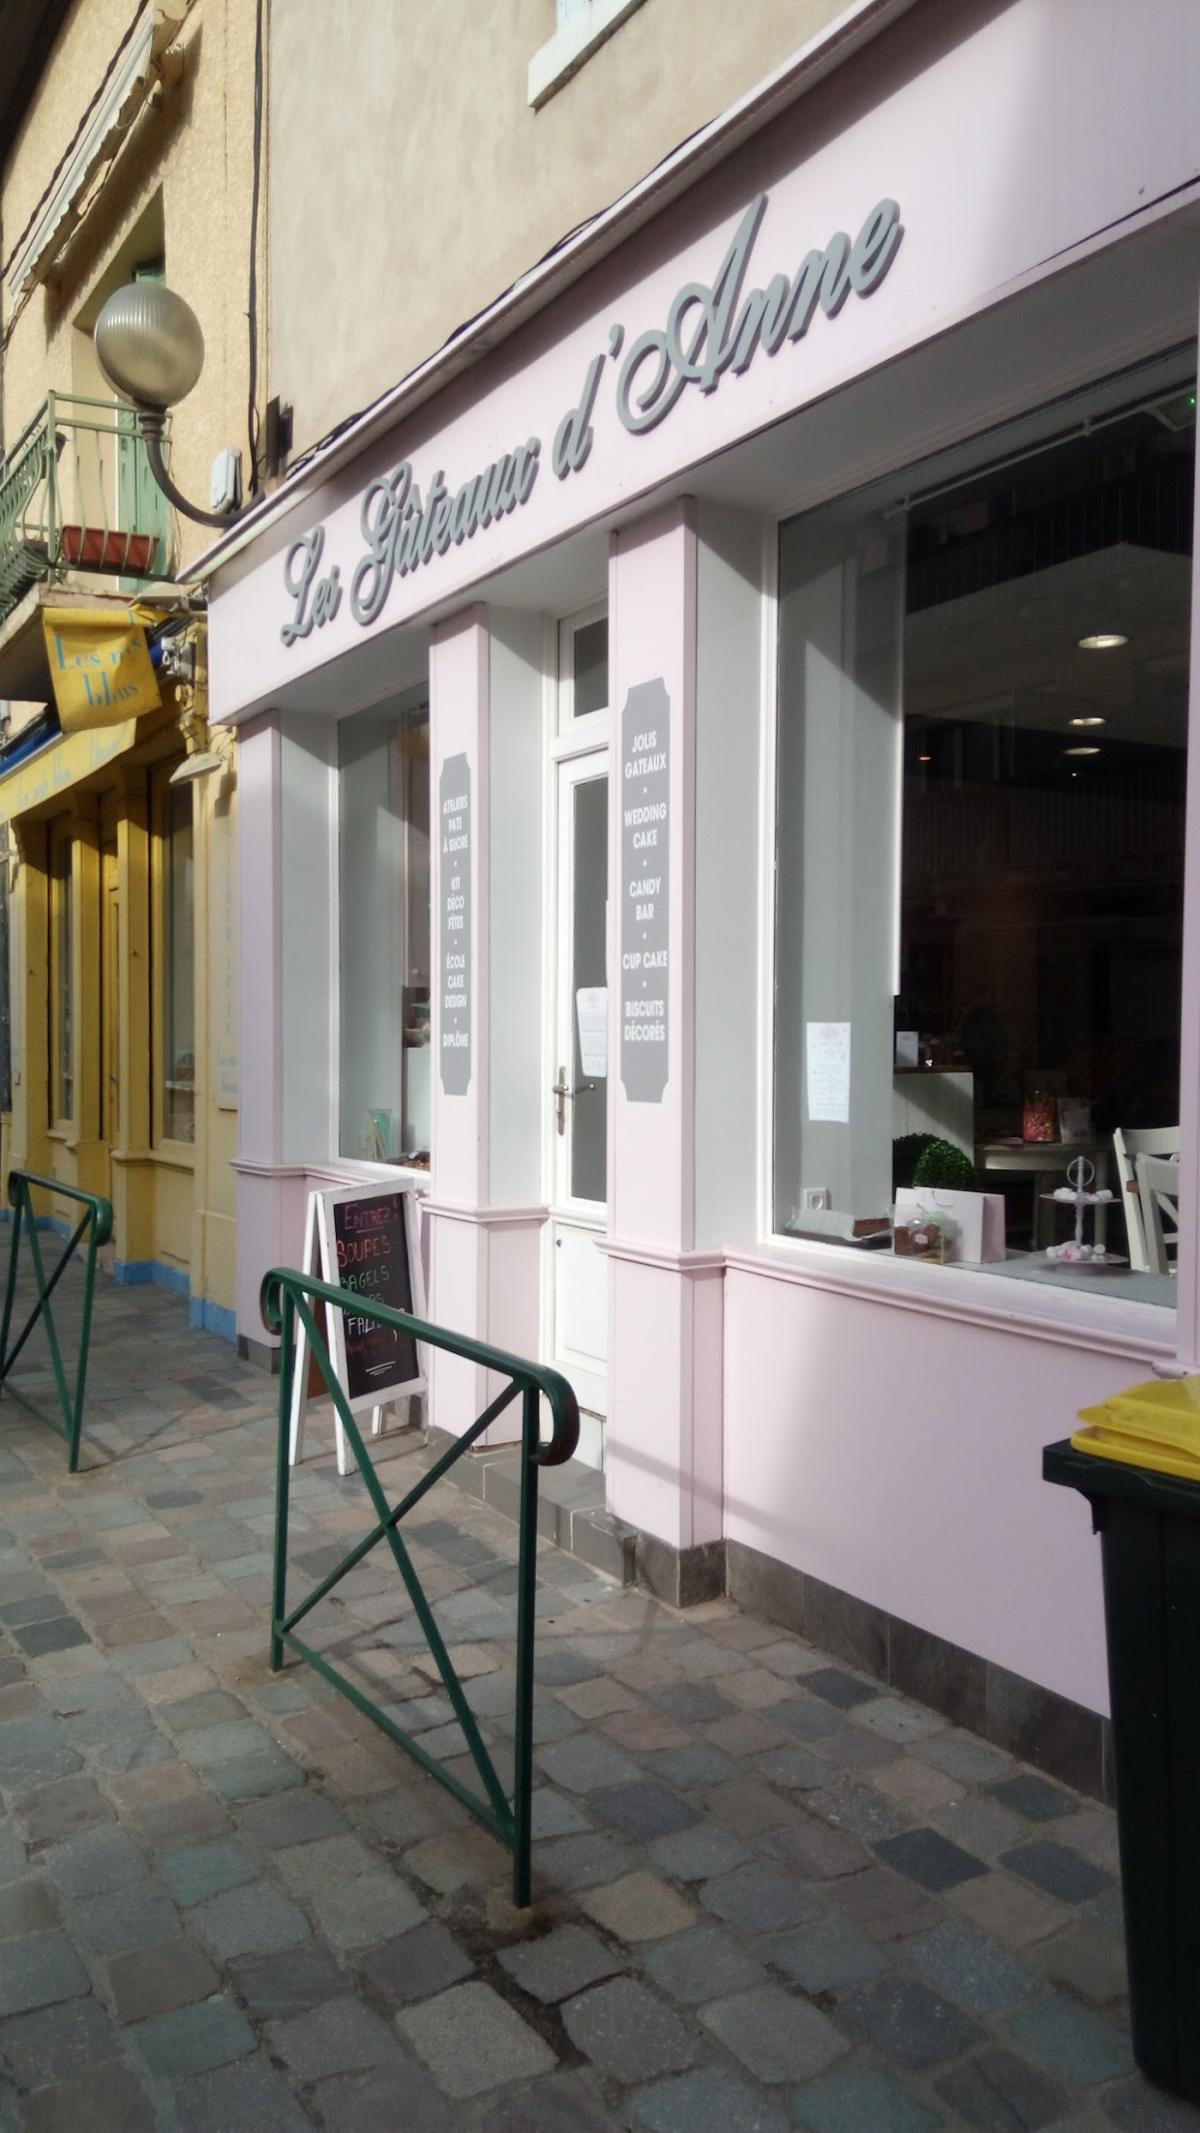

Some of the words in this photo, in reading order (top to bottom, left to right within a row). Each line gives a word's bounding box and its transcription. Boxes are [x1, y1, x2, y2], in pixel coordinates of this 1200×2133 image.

[281, 524, 342, 648] Les
[350, 461, 541, 626] Gâteaux
[552, 192, 904, 480] d'Anne
[55, 633, 101, 671] Les
[632, 730, 657, 752] JOLIS
[625, 753, 666, 779] GATEAUX
[443, 794, 468, 814] ATELIERS
[624, 803, 667, 827] WEDDING
[449, 834, 468, 851] SUCRE
[633, 829, 658, 849] CAKE
[451, 876, 460, 890] KIT
[629, 877, 661, 898] CANDY
[447, 893, 465, 911] DÉCO
[636, 903, 654, 921] BAR
[446, 954, 465, 969] ÉCOLE
[623, 952, 641, 970] CUP
[643, 950, 668, 968] CAKE
[448, 974, 464, 989] CAKE
[445, 994, 467, 1008] DESIGN
[625, 1000, 664, 1018] BISCUITS
[443, 1030, 469, 1047] DIPLÔME
[624, 1020, 665, 1042] DÉCORÉS
[336, 1235, 391, 1268] SOUPES
